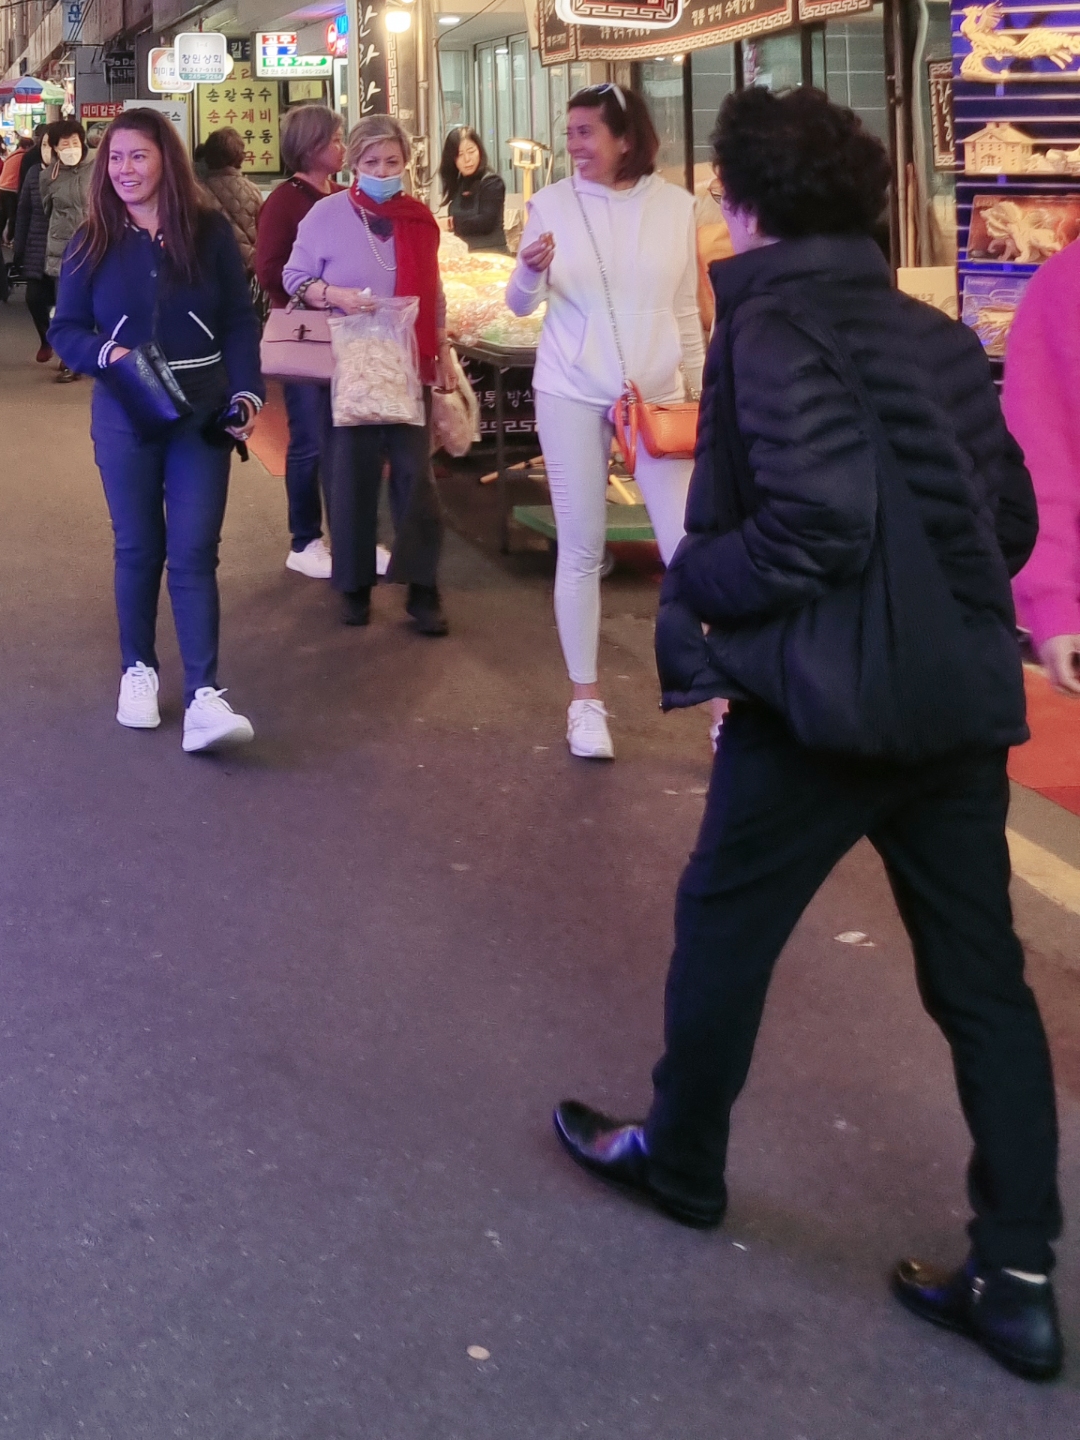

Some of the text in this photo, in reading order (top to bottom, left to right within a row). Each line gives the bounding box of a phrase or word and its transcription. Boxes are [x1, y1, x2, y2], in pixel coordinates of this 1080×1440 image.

[707, 2, 723, 23] 방식
[181, 54, 222, 65] 창원상회
[358, 5, 382, 114] 한라한
[153, 66, 176, 77] 미미칼
[206, 88, 273, 103] 손칼국수
[82, 105, 124, 117] 미미칼국수
[206, 110, 272, 124] 손수제비
